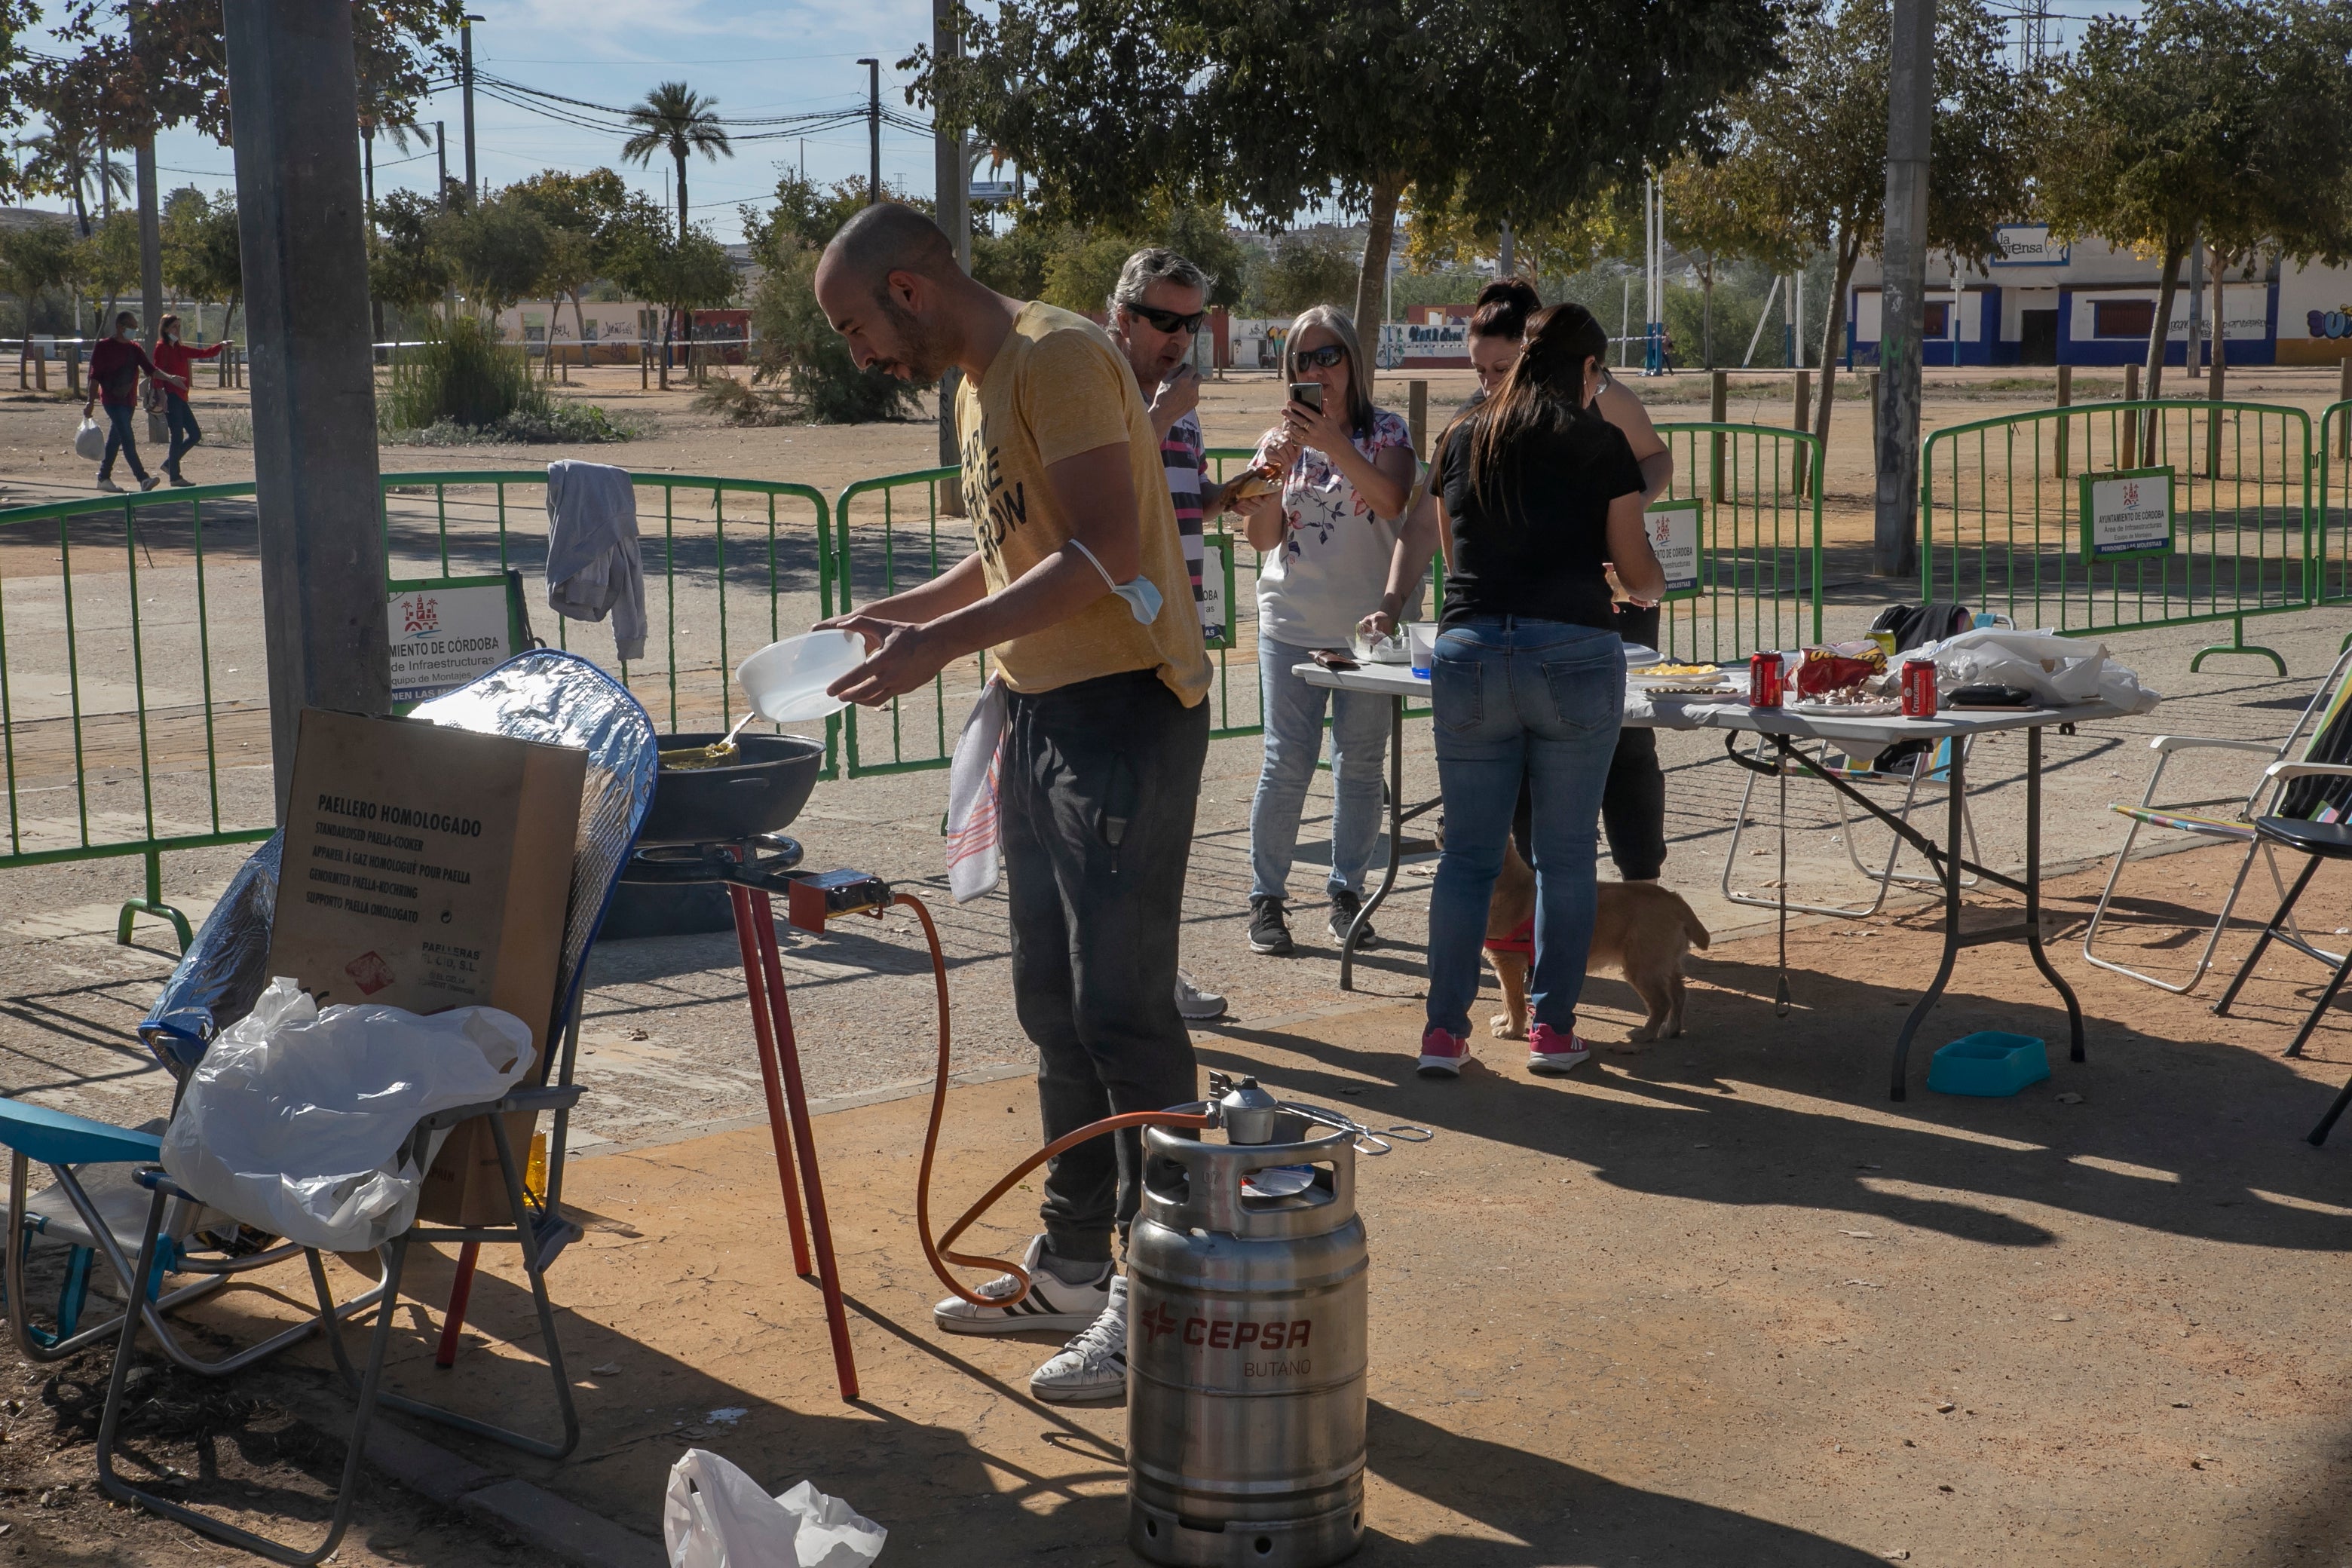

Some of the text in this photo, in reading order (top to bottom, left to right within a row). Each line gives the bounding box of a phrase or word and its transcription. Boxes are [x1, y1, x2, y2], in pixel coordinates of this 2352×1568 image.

[1999, 233, 2011, 244] la
[2098, 510, 2164, 524] AYUNTAMIENTO DE CÓRDOBA
[2124, 522, 2162, 531] Infraestructuras
[1666, 548, 1672, 558] DE
[1672, 546, 1693, 558] CÓRDOBA
[2136, 541, 2162, 549] MOLESTIAS
[1668, 580, 1691, 589] MOLESTIAS
[431, 642, 445, 654] DE
[448, 636, 499, 653] CÓRDOBA
[391, 656, 495, 672] de Infraestructuras
[418, 674, 429, 682] de
[432, 672, 472, 683] Montajes
[1754, 664, 1762, 703] Cruzcampo
[415, 688, 435, 699] LAS
[1912, 672, 1921, 713] Cruzcampo
[317, 794, 482, 838] PAELLERO HOMOLOGADO
[315, 822, 424, 852] STANDARDISED PAELLA-COOKER
[312, 845, 470, 884] APPAREIL À GAZ HOMOLOGUÉ POUR PAELLA
[309, 868, 418, 899] GENORMTER PAELLA-KOCHRING
[306, 891, 418, 923] SUPPORTO PAELLA OMOLOGATO
[422, 942, 481, 960] PAELLERAS
[431, 1167, 455, 1182] PAIN
[1182, 1317, 1312, 1350] CEPSA
[1244, 1358, 1311, 1377] BUTANO
